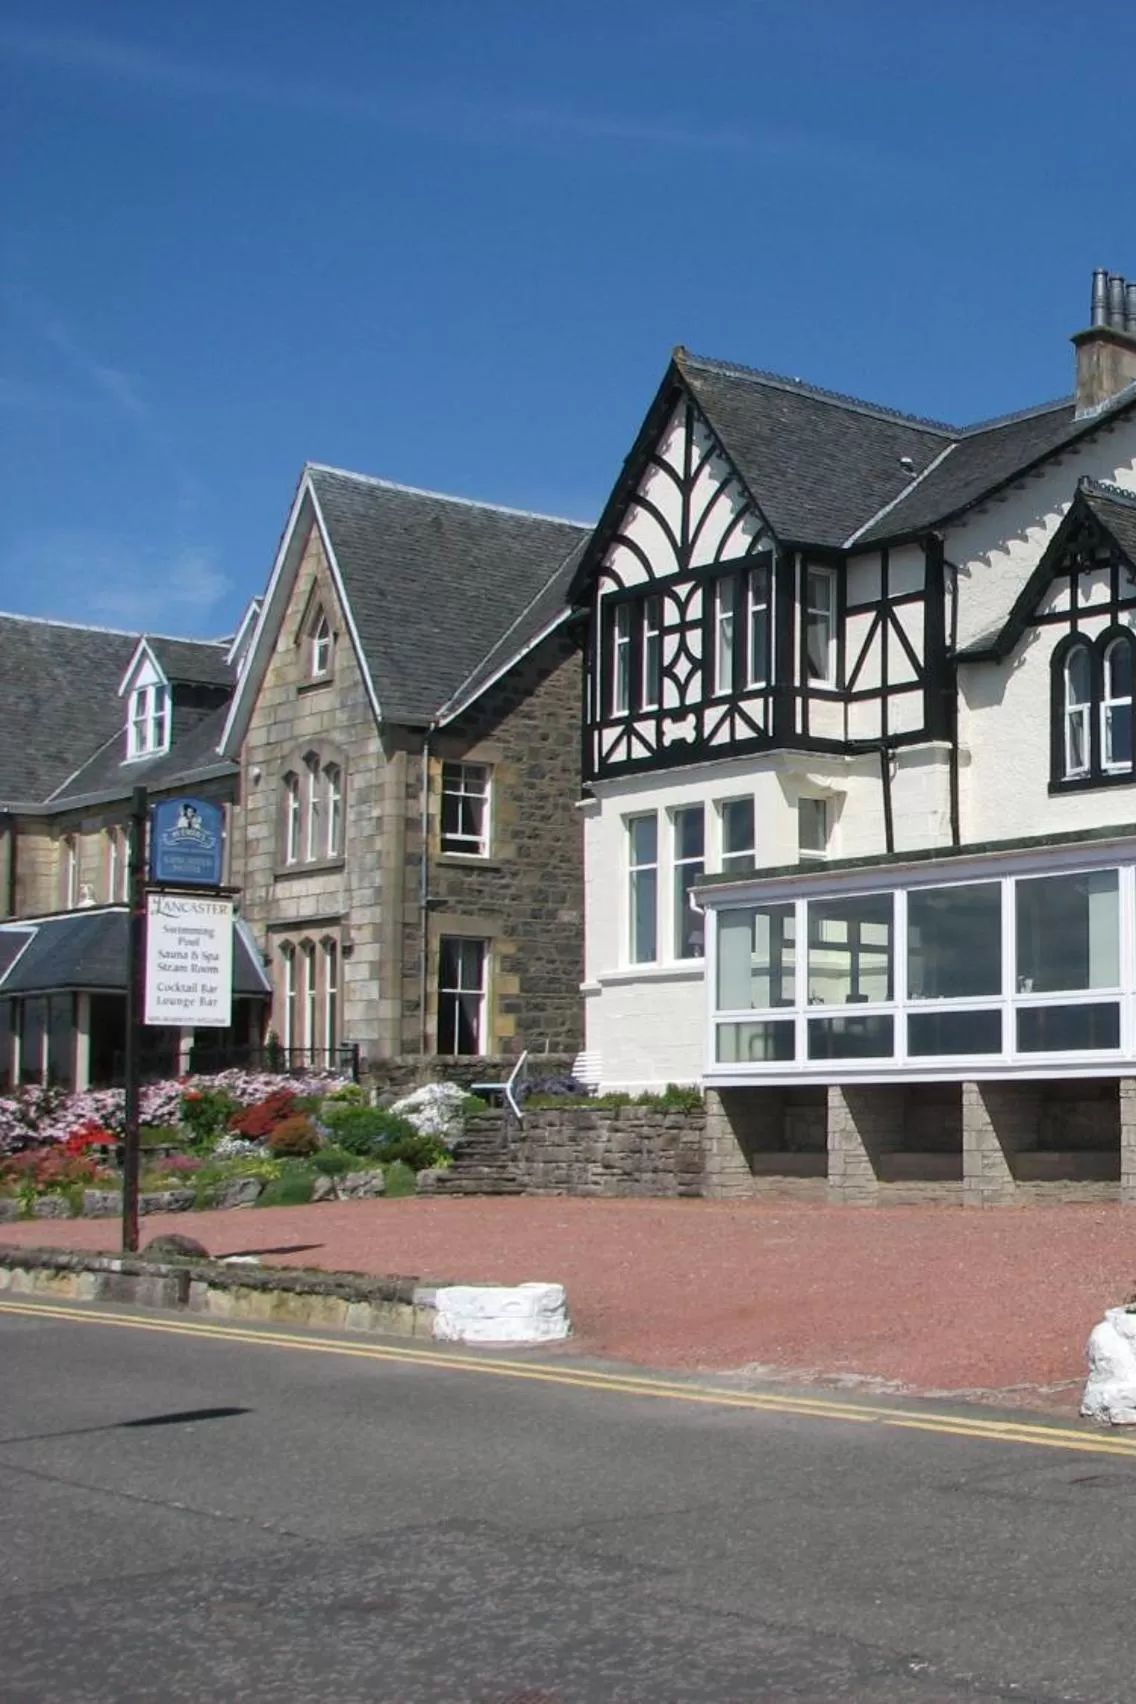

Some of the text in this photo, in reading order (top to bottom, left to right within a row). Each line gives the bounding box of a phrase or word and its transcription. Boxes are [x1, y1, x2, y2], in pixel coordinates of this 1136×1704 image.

[152, 896, 229, 918] LANCASTER
[163, 924, 215, 939] Swimming
[178, 936, 201, 947] Pool
[157, 949, 189, 960] Sauna
[201, 951, 220, 963] Spa
[156, 962, 220, 975] Steam Room
[156, 981, 219, 994] Cocktail Bar
[156, 995, 219, 1009] Lounge Bar
